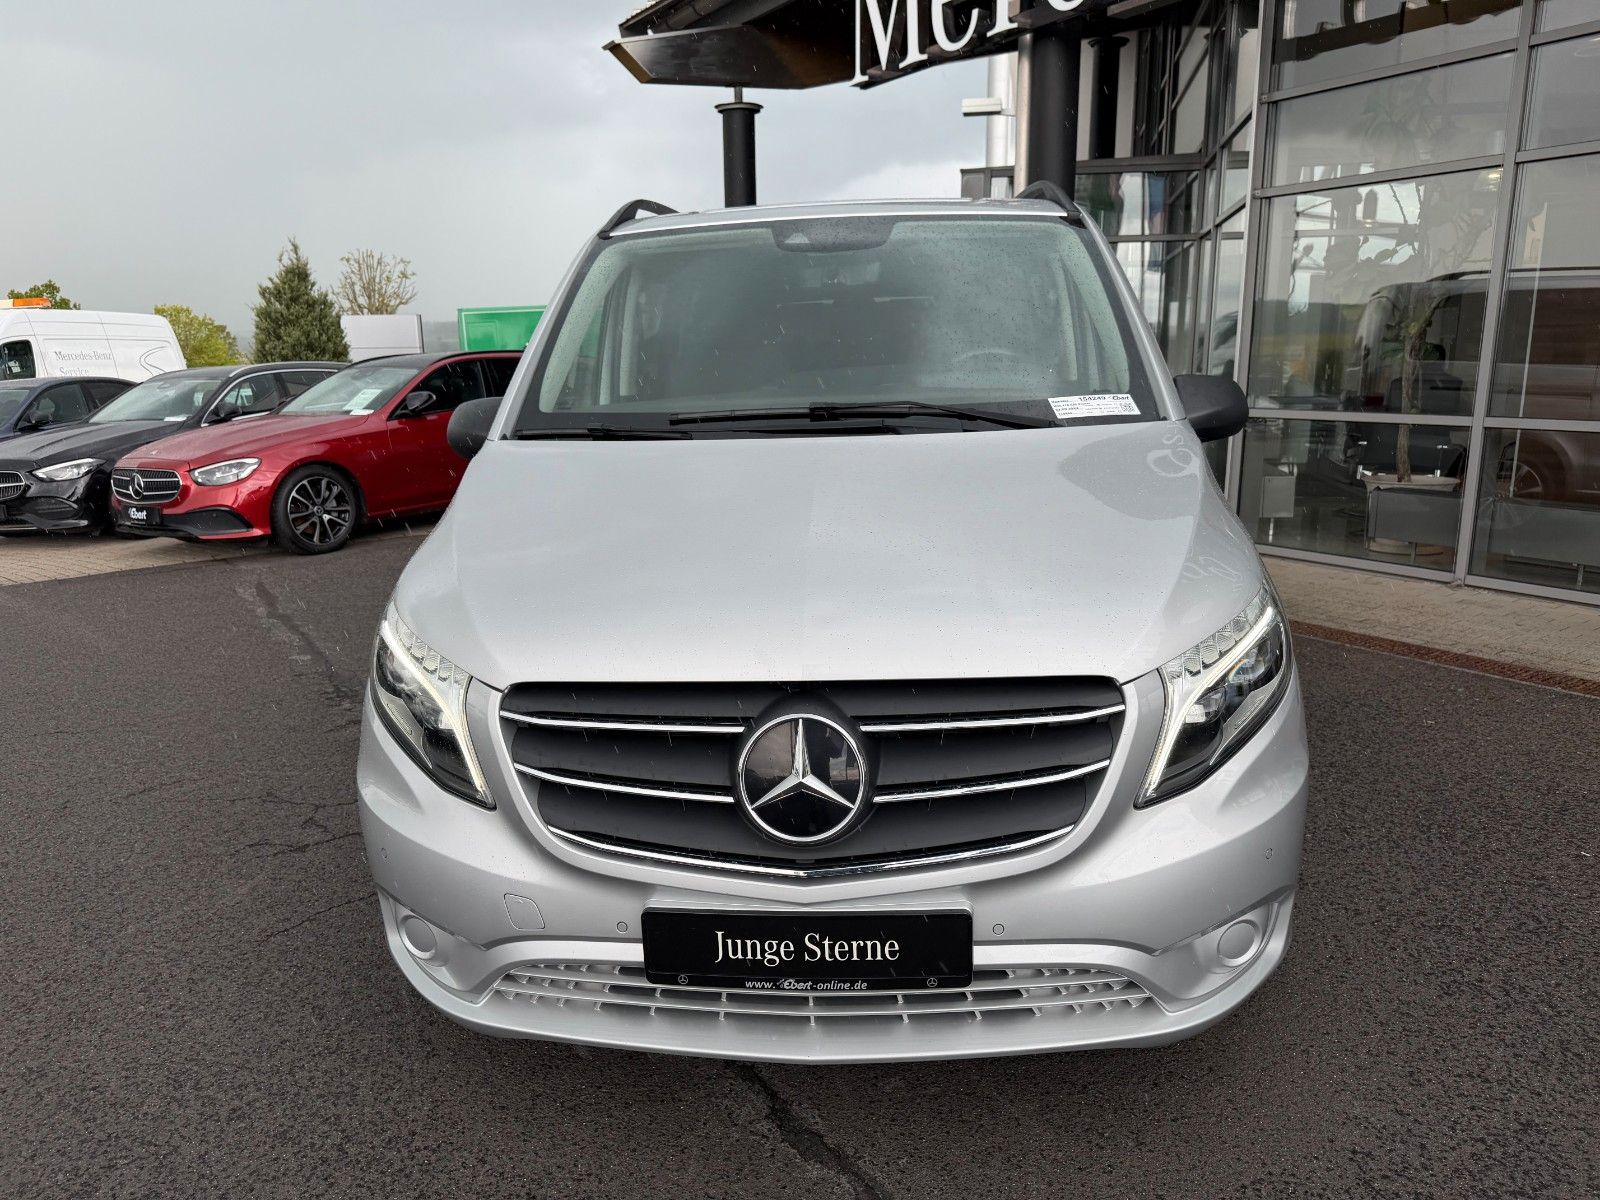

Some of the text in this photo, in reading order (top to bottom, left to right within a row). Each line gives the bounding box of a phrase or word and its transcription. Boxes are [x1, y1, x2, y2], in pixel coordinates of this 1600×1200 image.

[54, 350, 112, 361] Mercedes-Benz
[715, 931, 900, 967] Junge Sterne
